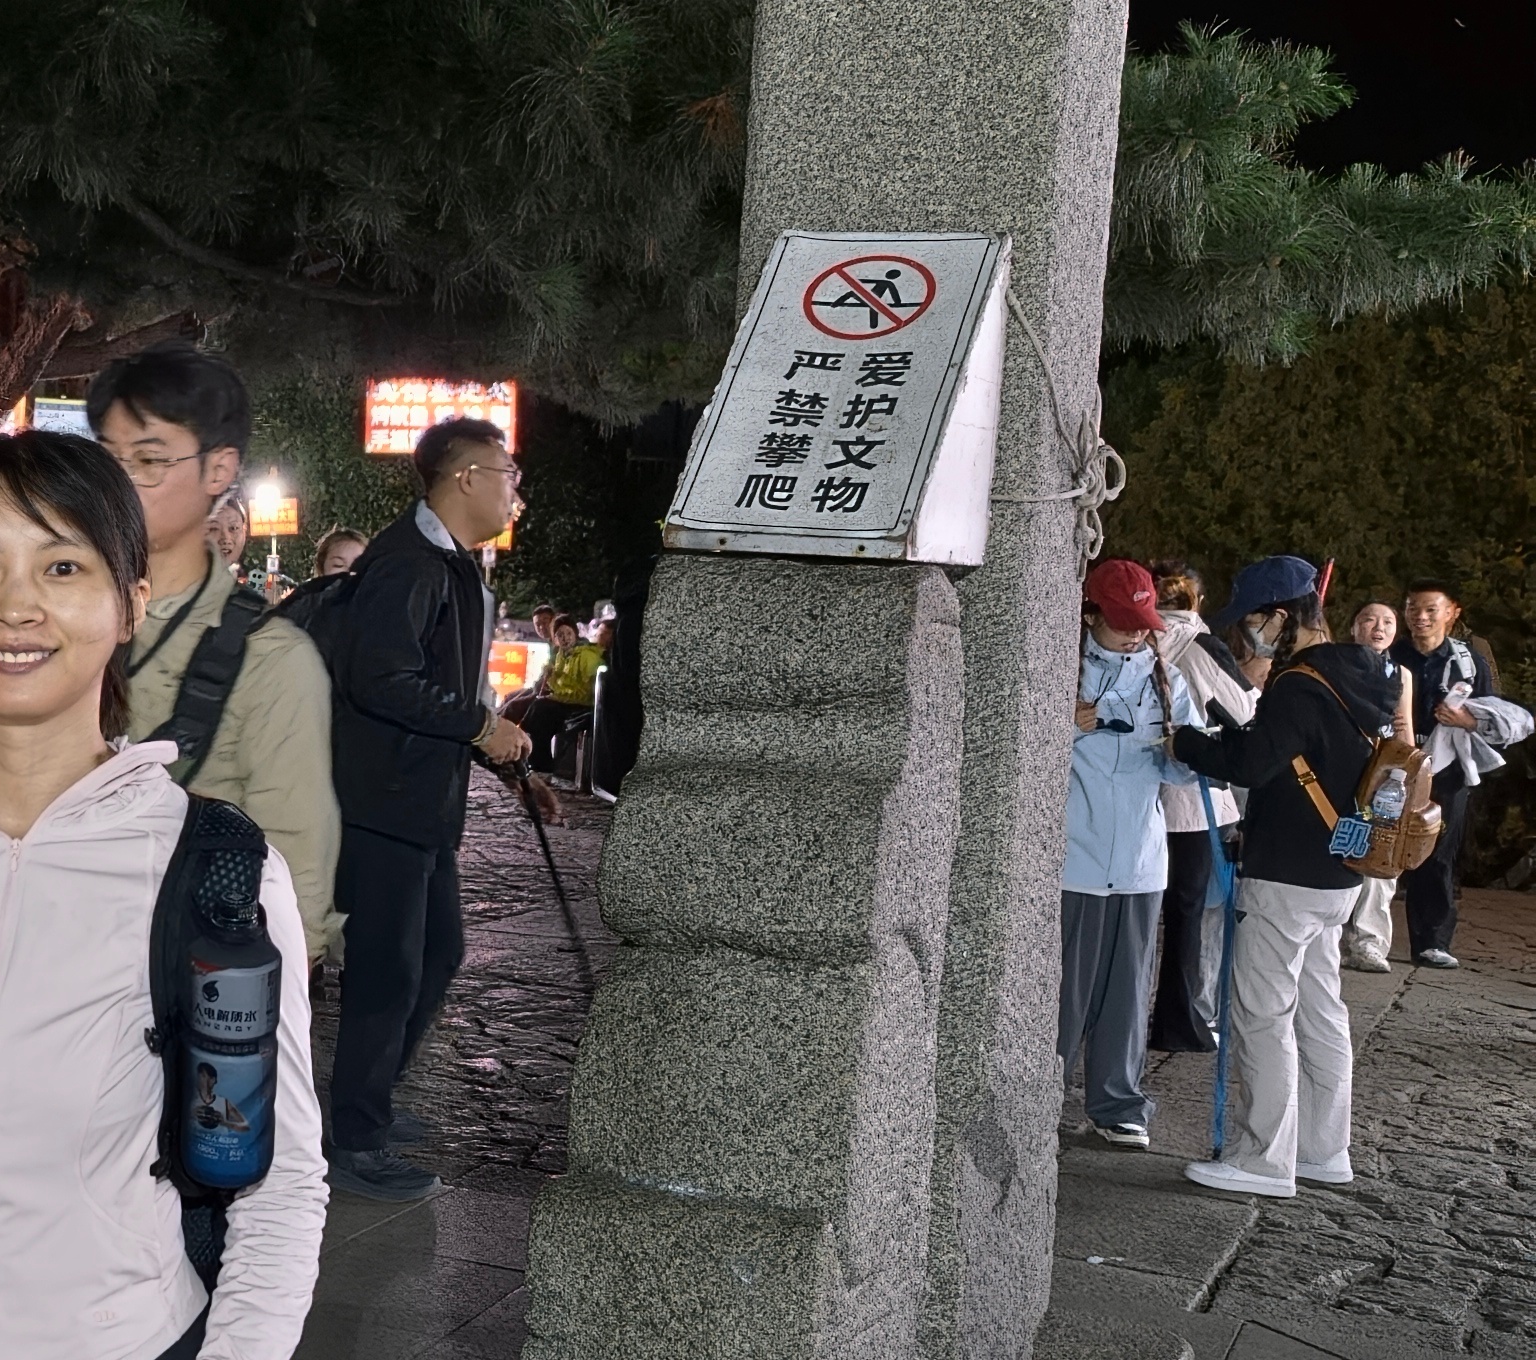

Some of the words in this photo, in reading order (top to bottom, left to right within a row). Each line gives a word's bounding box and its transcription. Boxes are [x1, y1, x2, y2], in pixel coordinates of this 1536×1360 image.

[734, 349, 846, 511] 严禁攀爬
[810, 350, 914, 514] 爱护文物
